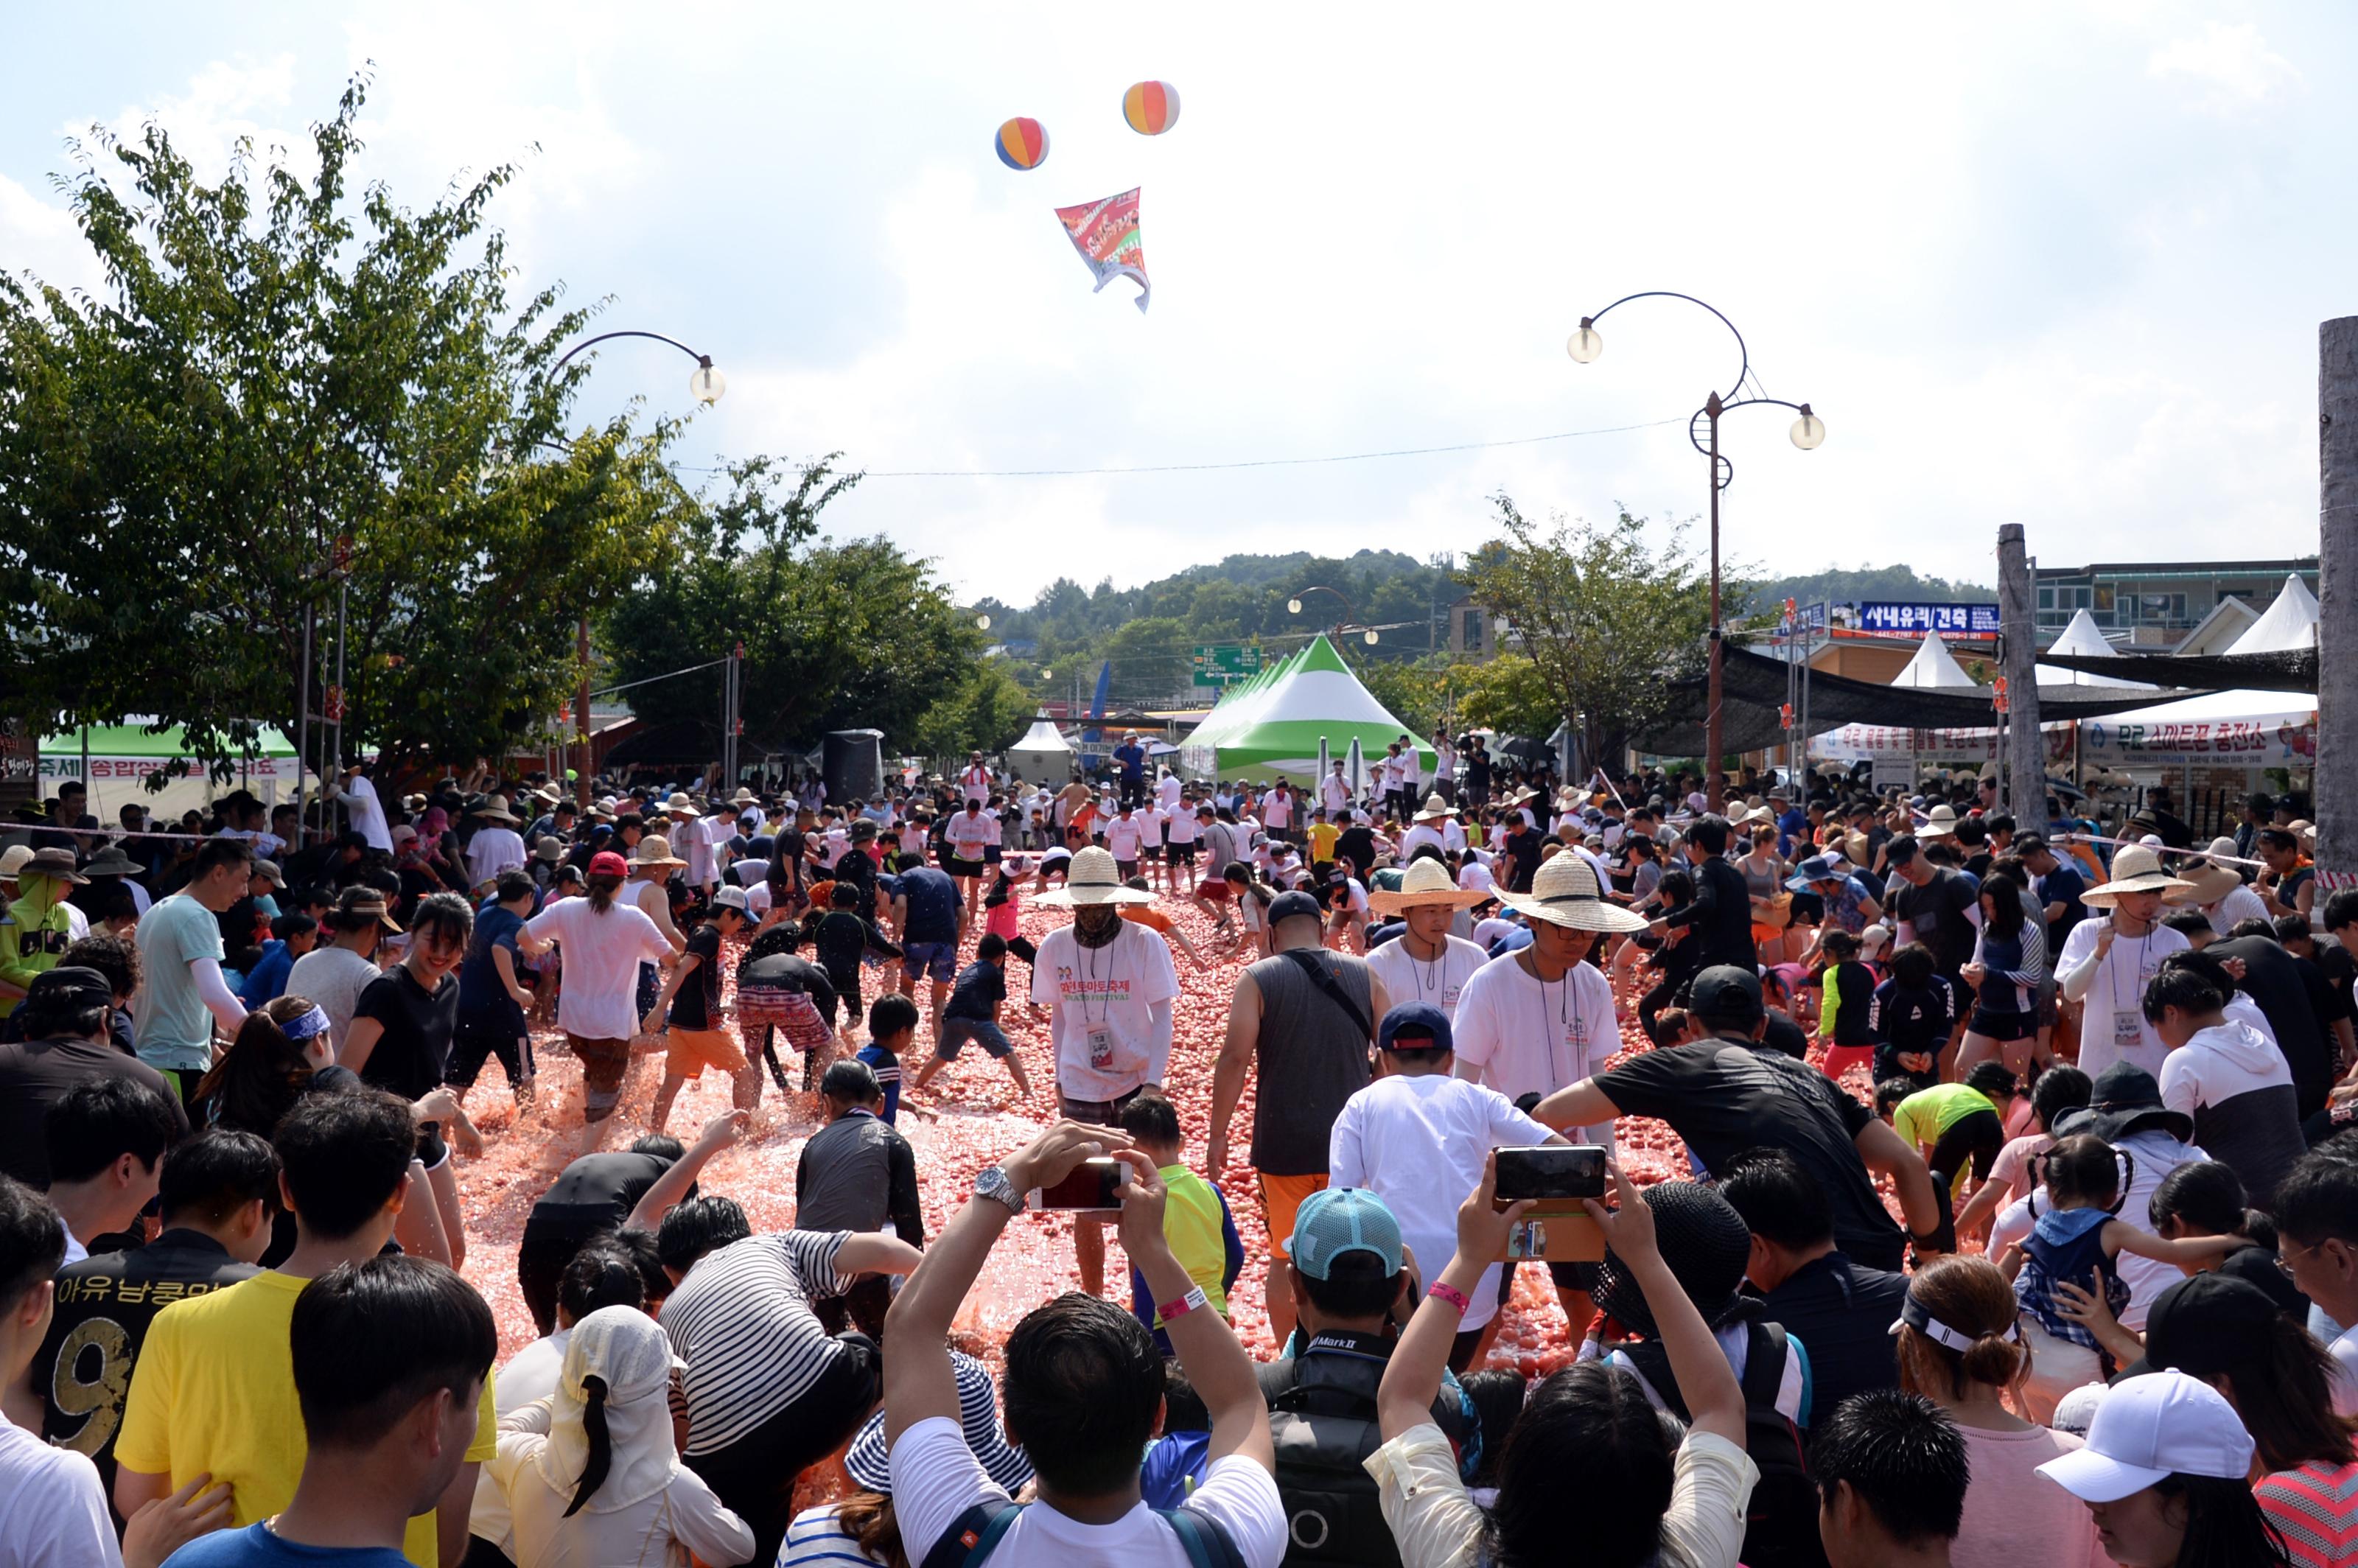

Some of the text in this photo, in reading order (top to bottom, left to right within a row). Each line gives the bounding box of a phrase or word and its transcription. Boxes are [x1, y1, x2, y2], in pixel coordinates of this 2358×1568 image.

[1867, 606, 1967, 629] 사내유리/건축
[1842, 727, 1861, 748] 무료
[1866, 727, 1884, 749] 물품
[2117, 721, 2267, 752] 무료 스마트폰 충전소
[58, 1275, 112, 1303] 아유
[52, 1317, 133, 1458] 9
